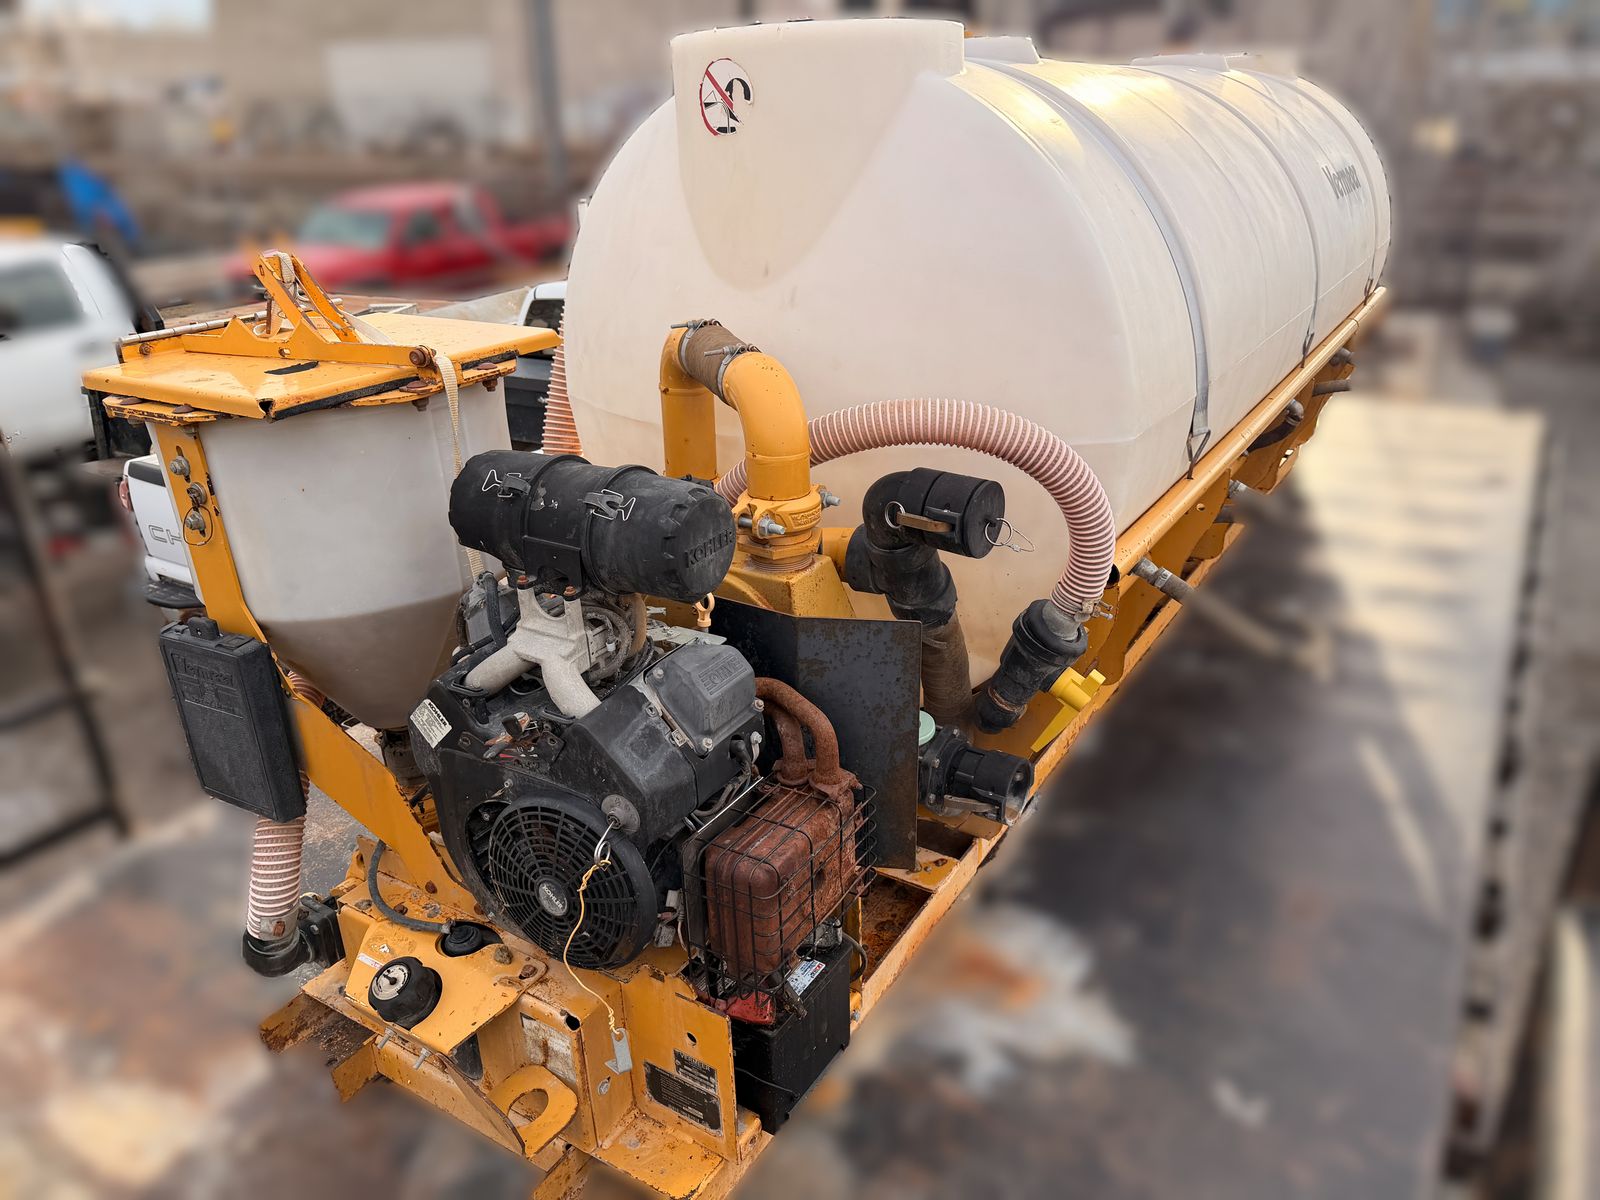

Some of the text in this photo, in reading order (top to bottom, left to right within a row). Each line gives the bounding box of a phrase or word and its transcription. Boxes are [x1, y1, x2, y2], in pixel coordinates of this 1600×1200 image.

[1321, 164, 1361, 200] Vermeer
[684, 528, 734, 569] KOHLER
[428, 701, 448, 727] KOHLER
[542, 884, 563, 909] KOHLER
